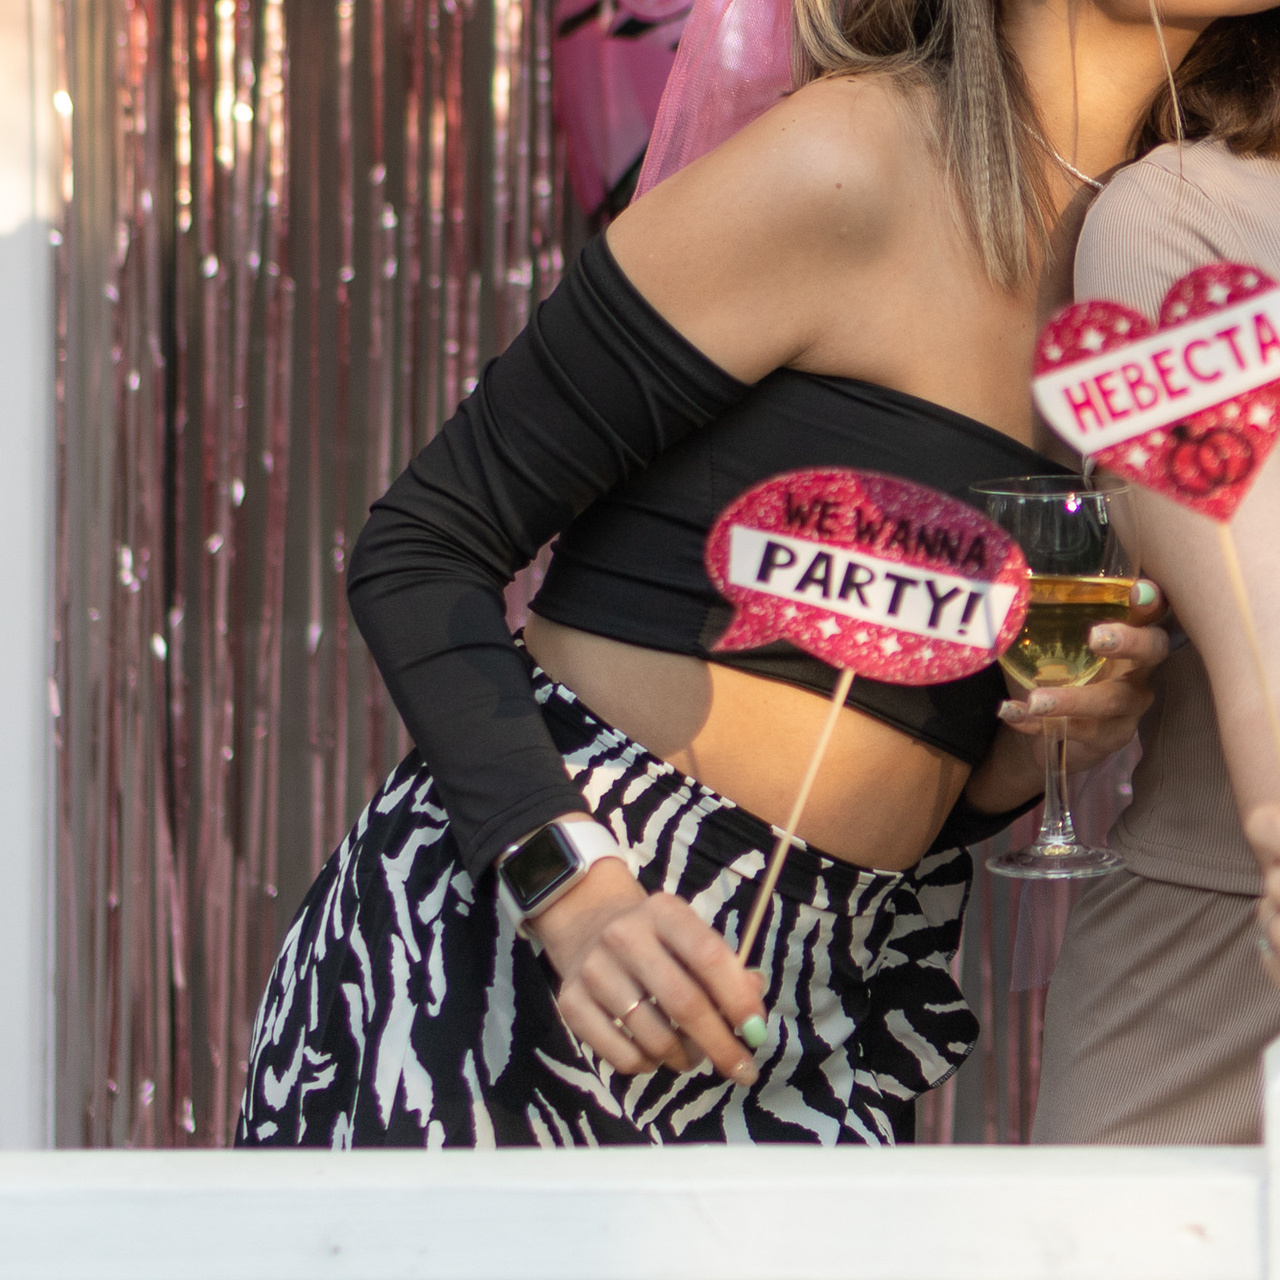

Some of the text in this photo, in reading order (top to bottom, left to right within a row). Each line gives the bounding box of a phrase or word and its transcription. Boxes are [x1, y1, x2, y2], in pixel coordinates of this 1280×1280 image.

[782, 491, 989, 568] WE WANNA
[755, 540, 985, 637] PARTY!
